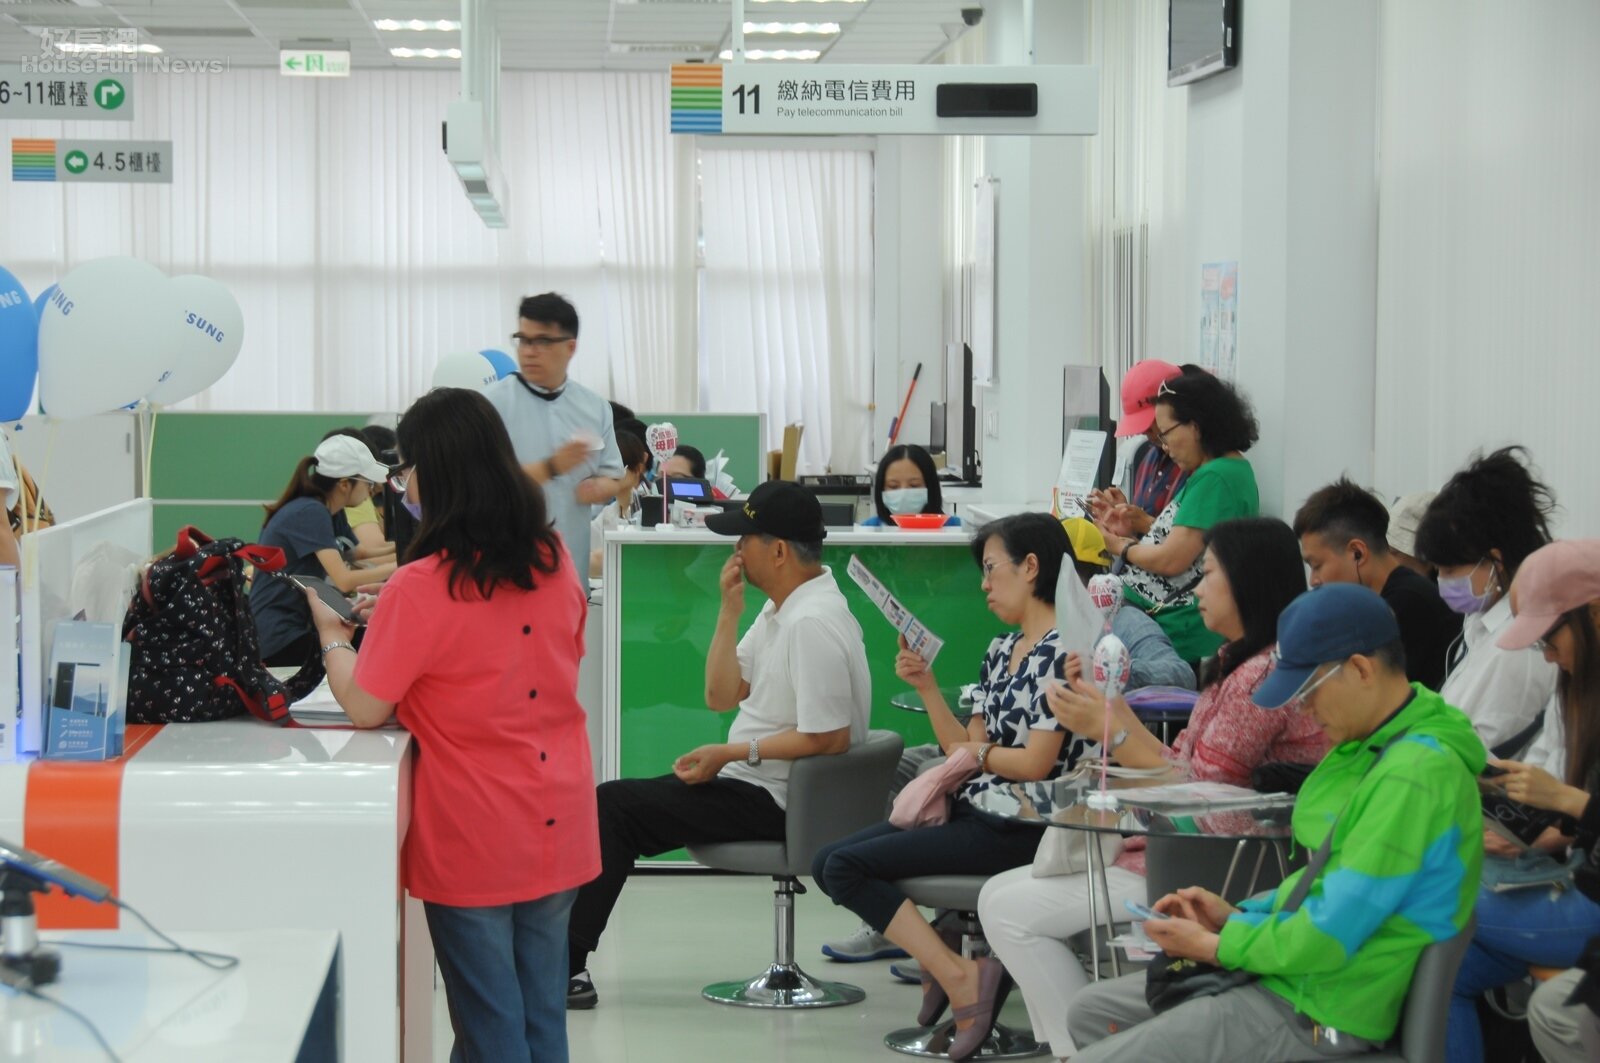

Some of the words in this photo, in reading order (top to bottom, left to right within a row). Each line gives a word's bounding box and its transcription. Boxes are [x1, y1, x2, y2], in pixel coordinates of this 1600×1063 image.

[732, 84, 761, 115] 11
[777, 79, 915, 101] 繳納電信費用
[777, 107, 796, 119] Pay
[797, 107, 888, 118] telecommunication
[889, 107, 903, 117] bill
